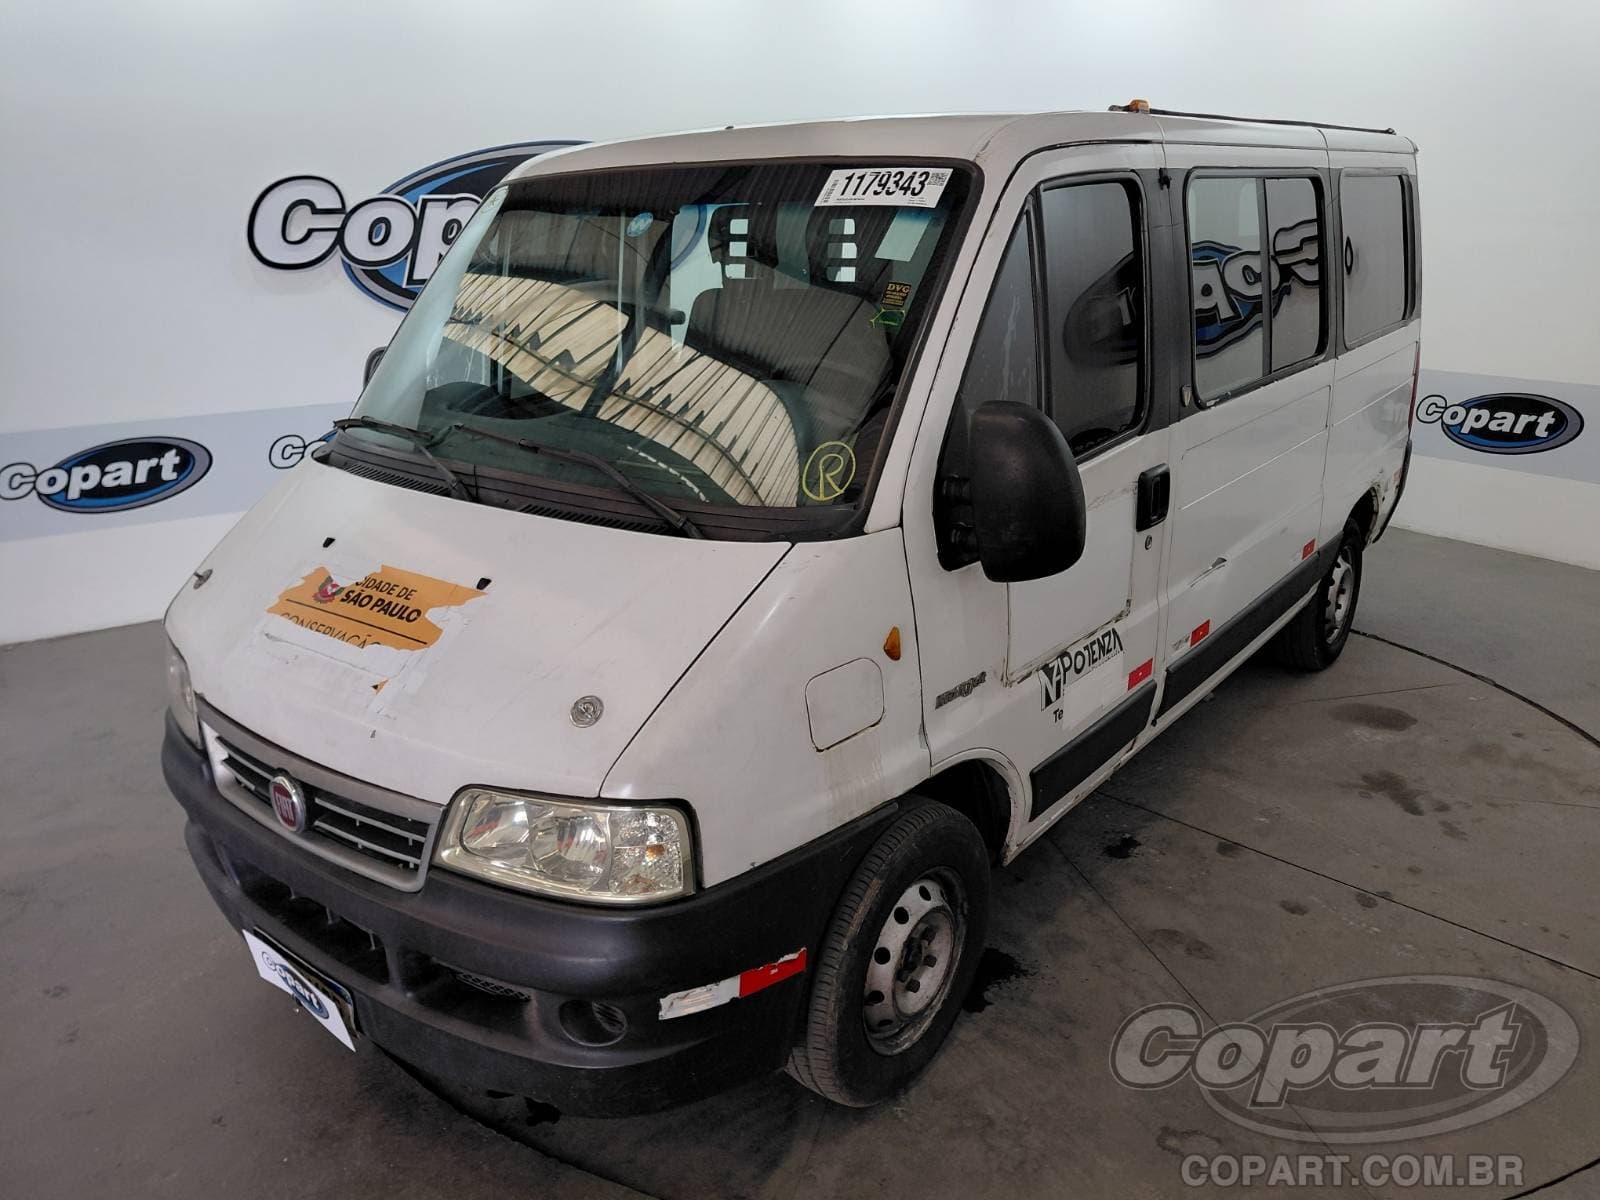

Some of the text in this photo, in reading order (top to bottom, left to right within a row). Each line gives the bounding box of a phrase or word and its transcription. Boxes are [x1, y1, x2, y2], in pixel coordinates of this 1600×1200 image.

[840, 171, 930, 196] 1179343
[247, 174, 486, 286] Cop
[1416, 394, 1556, 438] Copart
[0, 449, 181, 500] Copart
[341, 589, 422, 623] SÃO PAULO
[396, 586, 418, 601] DE
